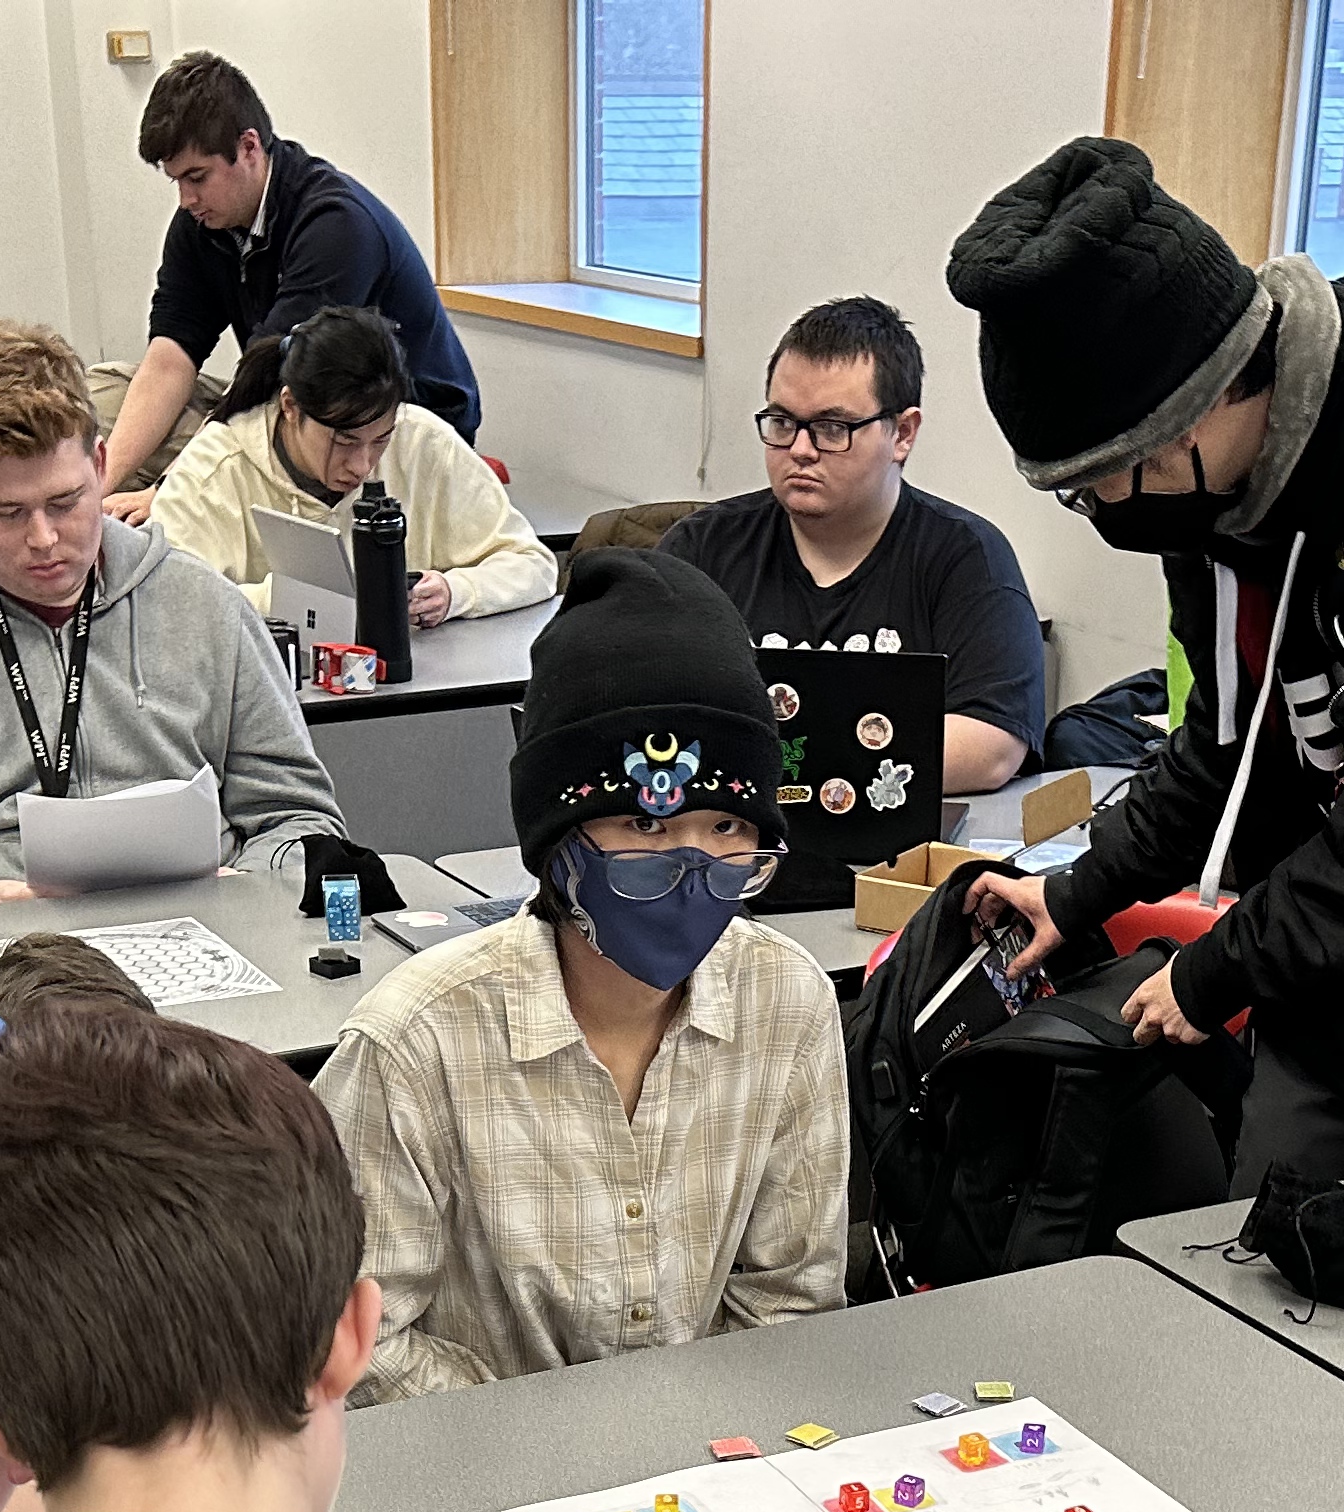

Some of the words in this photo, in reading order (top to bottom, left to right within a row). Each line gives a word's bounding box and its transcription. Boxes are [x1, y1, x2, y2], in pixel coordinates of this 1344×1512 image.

[76, 610, 89, 638] WPI
[9, 662, 25, 691] WPI
[66, 676, 80, 704] WPI
[30, 729, 46, 758] WPI
[57, 744, 71, 772] WPI
[941, 1021, 967, 1052] ARTEZA
[855, 1497, 865, 1510] 5
